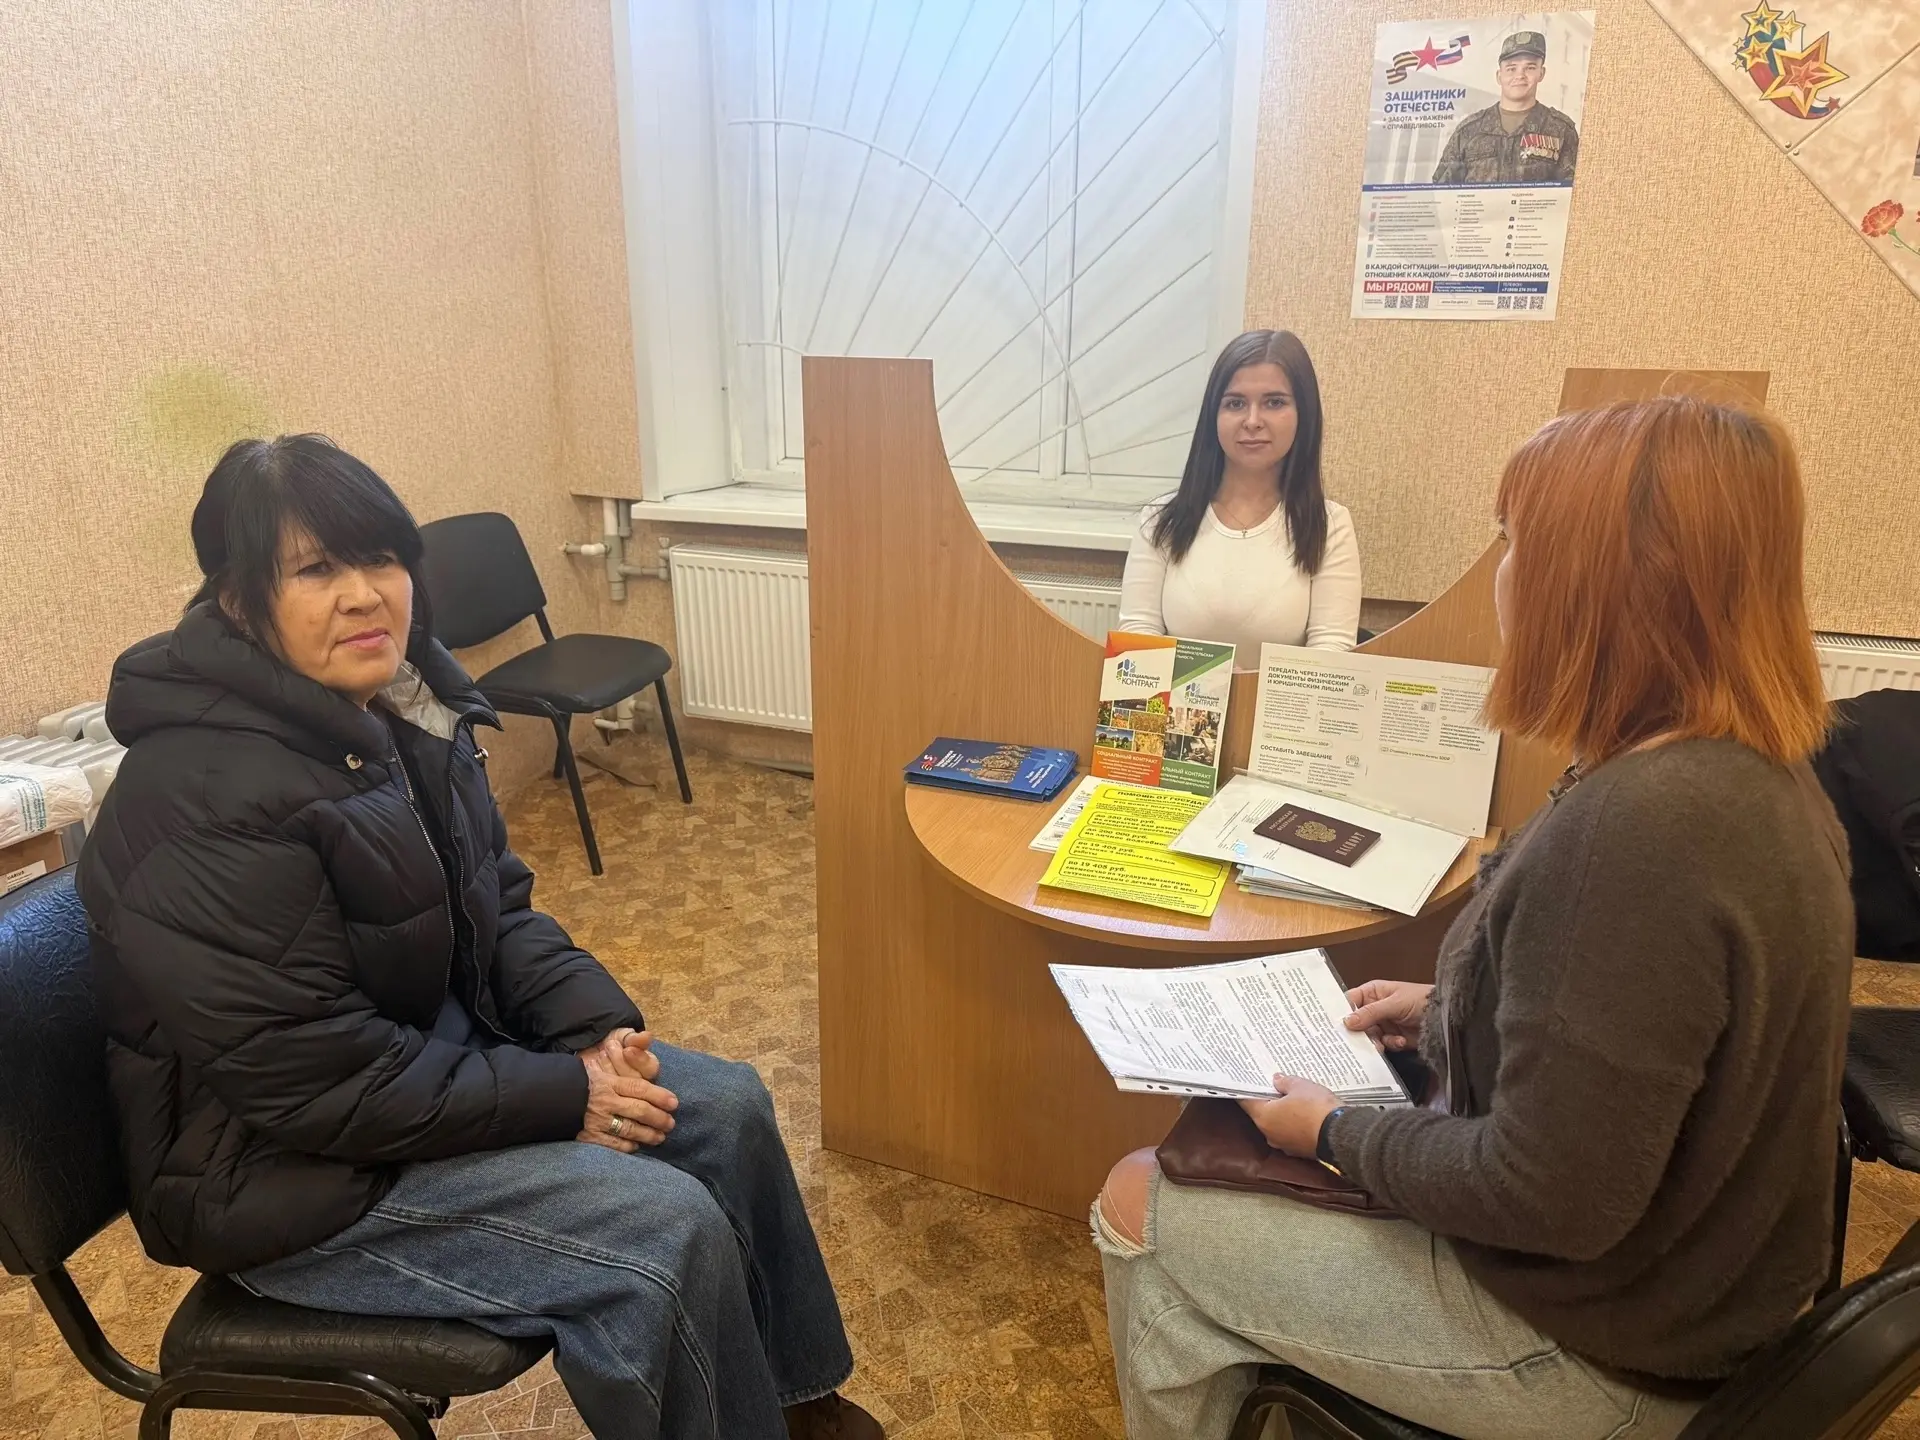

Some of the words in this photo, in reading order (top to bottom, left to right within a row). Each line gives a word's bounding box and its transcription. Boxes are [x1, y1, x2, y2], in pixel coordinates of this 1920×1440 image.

[1385, 89, 1466, 102] ЗАЩИТНИКИ
[1384, 101, 1455, 113] ОТЕЧЕСТВА
[1387, 122, 1445, 130] СПРАВЕДЛИВОСТЬ
[1371, 262, 1401, 271] КАЖДОЙ
[1448, 262, 1515, 271] ИНДИВИДУАЛЬНЫЙ
[1516, 263, 1549, 271] ПОДХОД,
[1365, 271, 1406, 279] ОТНОШЕНИЕ
[1412, 271, 1450, 279] КАЖДОМУ
[1465, 269, 1498, 278] ЗАБОТОЙ
[1367, 282, 1385, 292] МЫ
[1386, 281, 1429, 293] РЯДОМ!
[1267, 673, 1306, 682] ДОКУМЕНТЫ
[1307, 678, 1350, 687] ФИЗИЧЕСКИМ
[1268, 666, 1299, 675] ПЕРЕДАТЬ
[1299, 670, 1318, 678] ЧЕРЕЗ
[1318, 673, 1355, 682] НОТАРИУСА
[1122, 679, 1160, 689] КОНТРАКТ
[1273, 681, 1320, 690] ЮРИДИЧЕСКИМ
[1321, 685, 1344, 693] ЛИЦАМ
[1188, 698, 1220, 708] КОНТРАКТ
[1096, 750, 1131, 760] СОЦИАЛЬНЫЙ
[1132, 756, 1158, 765] КОНТРАКТ
[1260, 744, 1294, 755] СОСТАВИТЬ
[1296, 750, 1333, 760] ЗАВЕЩАНИЕ
[1184, 770, 1212, 779] КОНТРАКТ
[1117, 791, 1155, 800] ПОМОЩЬ
[1335, 832, 1366, 856] ПАСПОРТ
